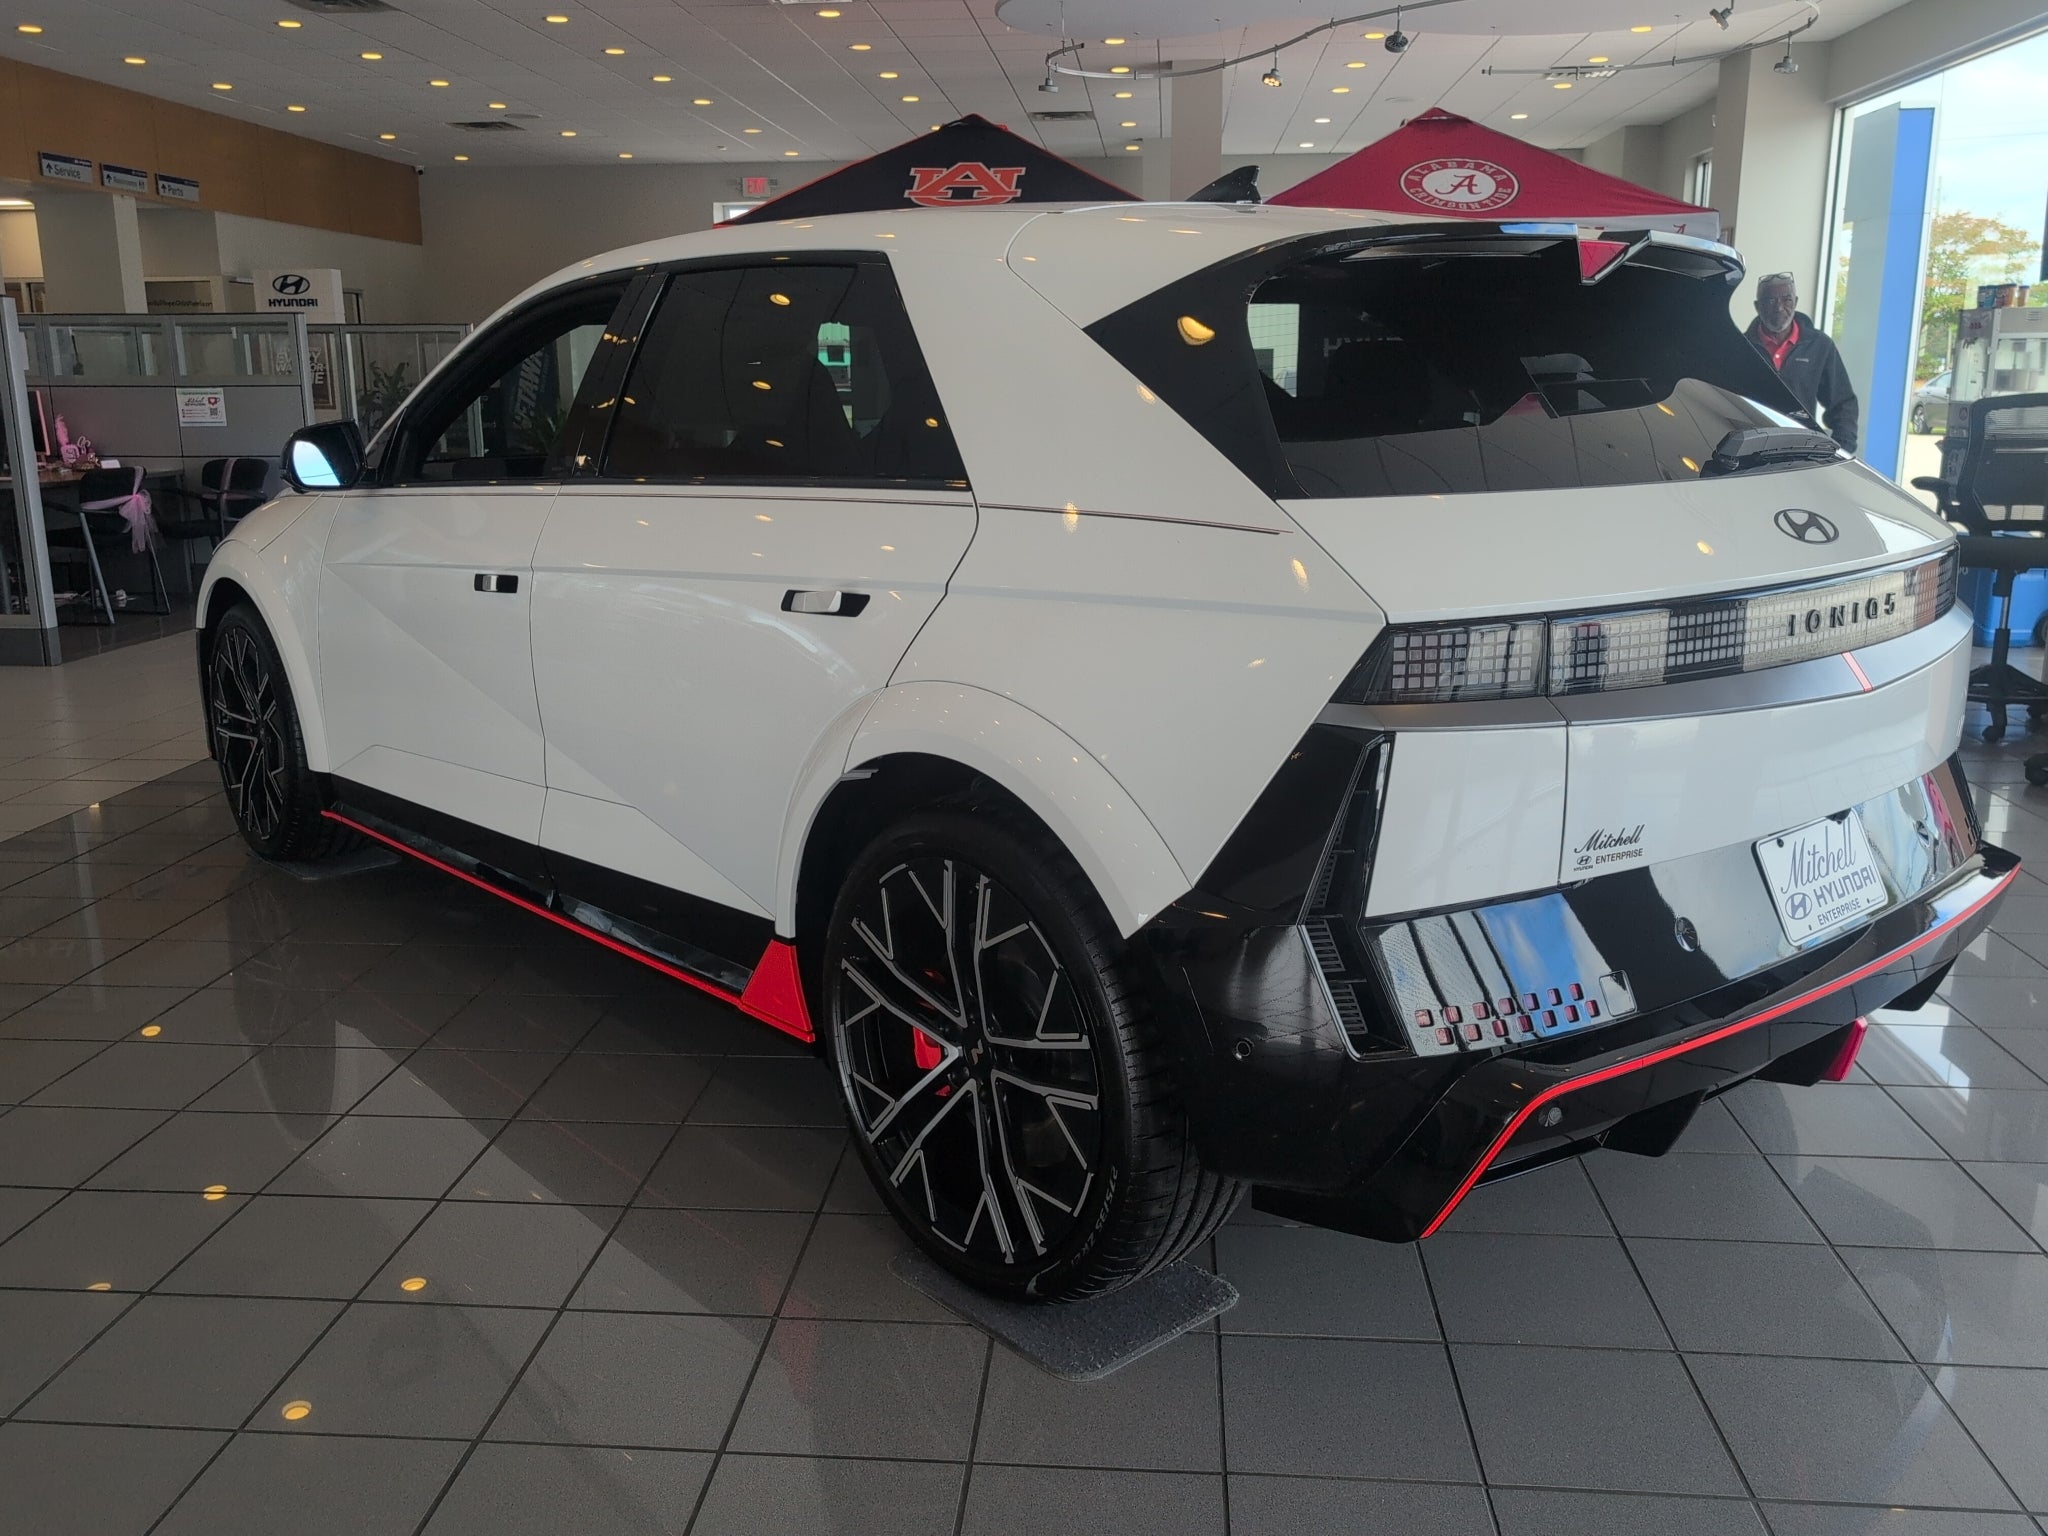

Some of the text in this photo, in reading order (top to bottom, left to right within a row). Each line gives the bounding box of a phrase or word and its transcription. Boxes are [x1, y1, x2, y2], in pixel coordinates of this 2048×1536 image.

[54, 164, 81, 180] Service
[1407, 161, 1507, 181] ALABAMA
[747, 177, 766, 193] EXIT
[1434, 174, 1482, 195] A
[1410, 187, 1512, 211] CRIMSON TIDE
[268, 298, 318, 307] HYUNDAI
[1574, 824, 1645, 853] Mitchell
[1595, 848, 1643, 864] ENTERPRISE
[1781, 817, 1856, 894] Mitchell
[1813, 865, 1877, 907] HYUNDAI
[1817, 898, 1861, 926] ENTERPRISE
